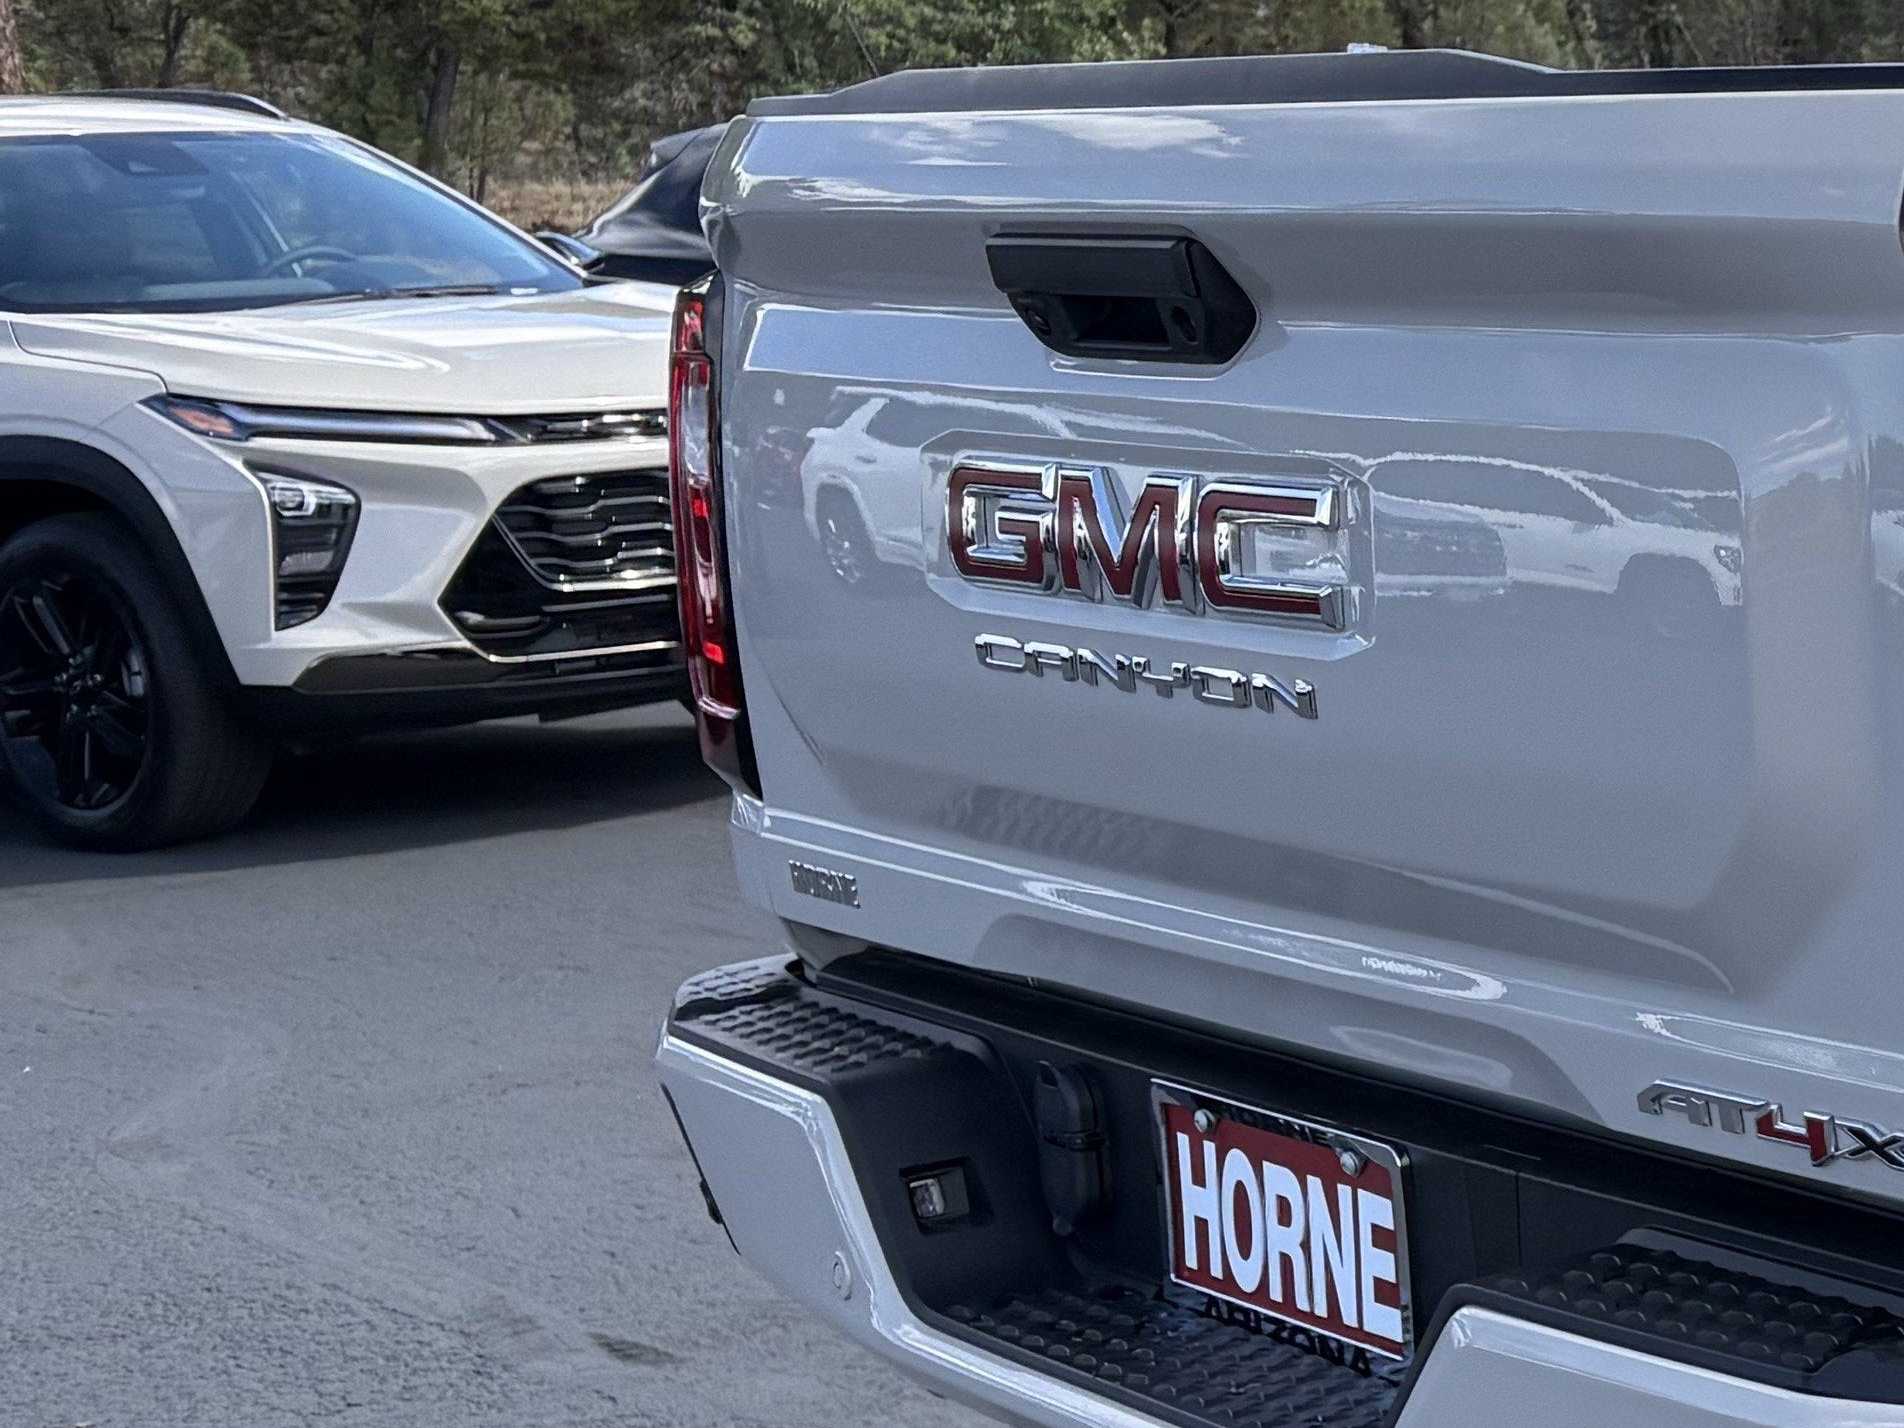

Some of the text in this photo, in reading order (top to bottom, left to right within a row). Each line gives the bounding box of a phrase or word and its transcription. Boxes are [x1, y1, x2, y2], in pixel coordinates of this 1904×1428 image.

[946, 454, 1346, 630] GMC
[974, 632, 1319, 720] CANYON
[1176, 1131, 1404, 1344] HORNE
